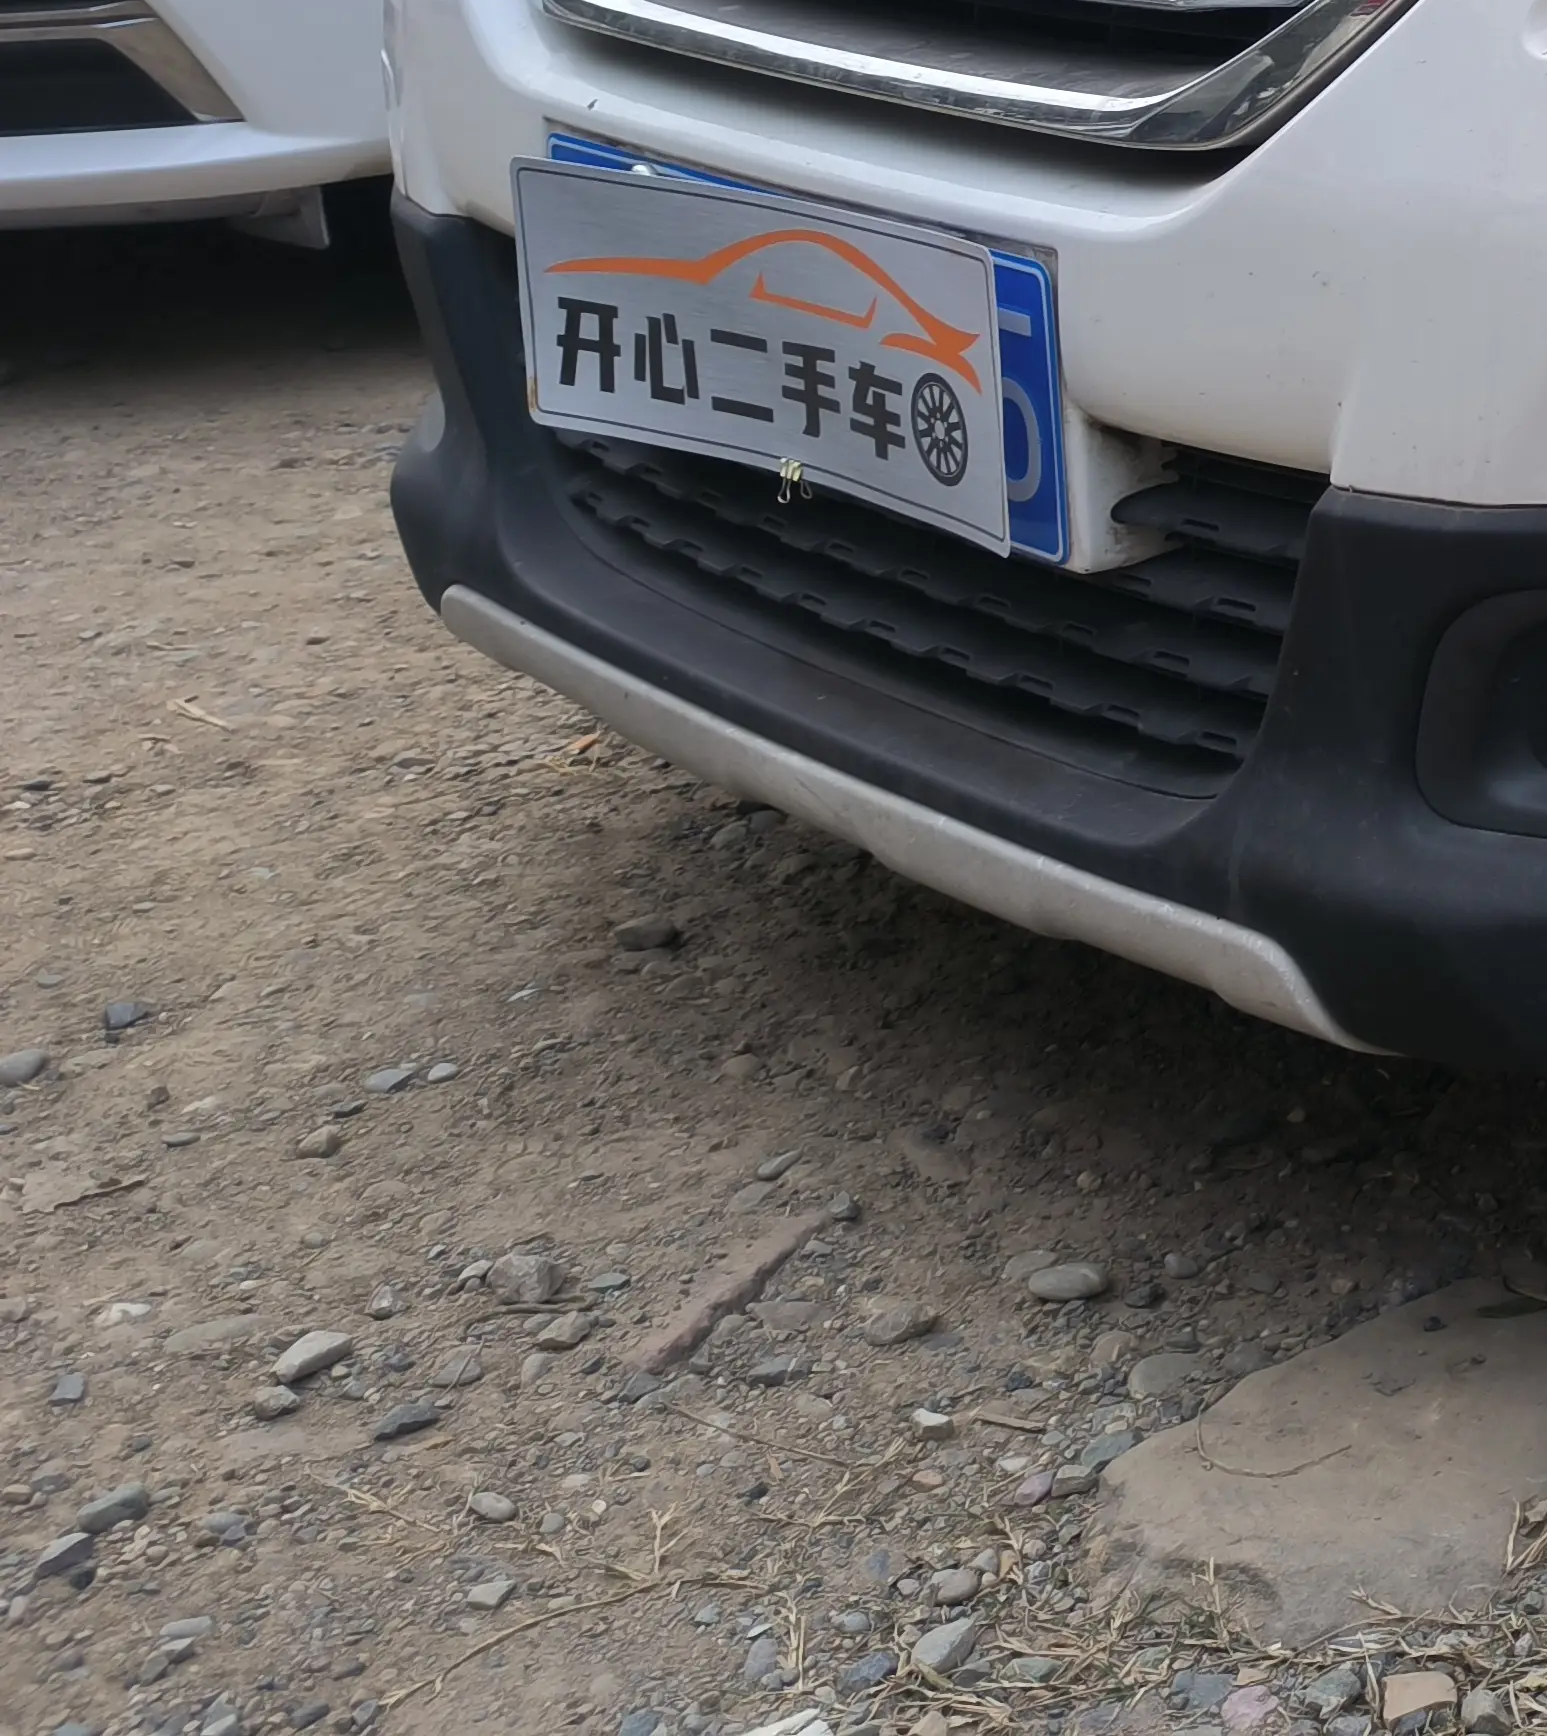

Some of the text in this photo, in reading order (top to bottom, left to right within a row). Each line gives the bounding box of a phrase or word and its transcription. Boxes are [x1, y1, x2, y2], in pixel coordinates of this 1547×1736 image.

[556, 295, 907, 462] 开心二手车
